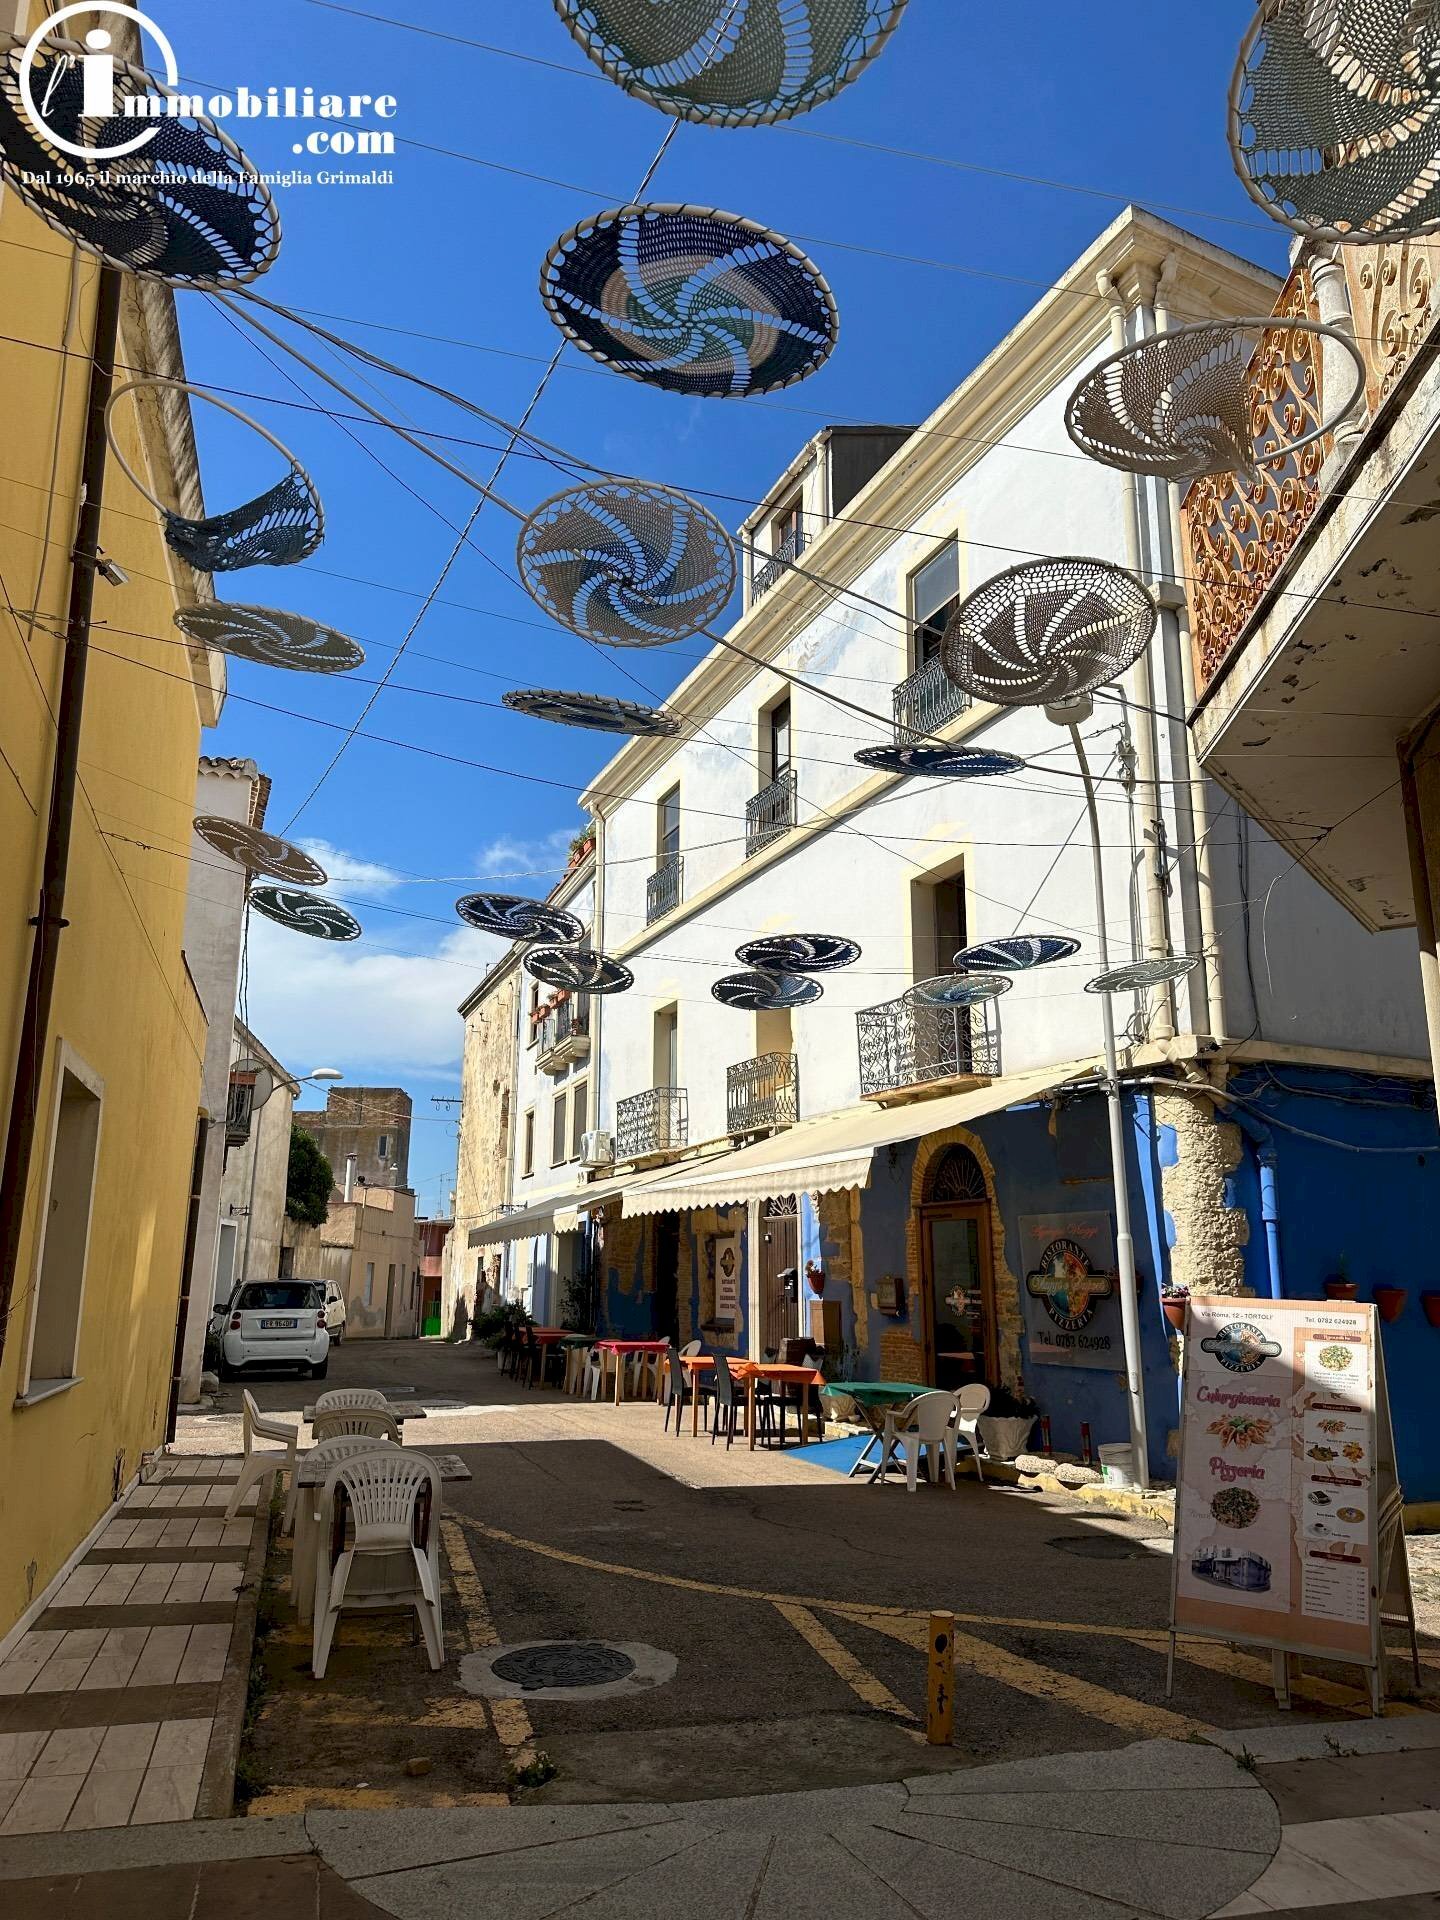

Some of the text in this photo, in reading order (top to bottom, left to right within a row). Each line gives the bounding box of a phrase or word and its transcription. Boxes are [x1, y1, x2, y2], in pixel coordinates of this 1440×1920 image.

[1041, 1240, 1090, 1271] RISTORANTE
[1048, 1308, 1094, 1331] PIZZERIA
[1218, 1323, 1266, 1338] RISTORANTE
[1078, 1335, 1112, 1350] 624928
